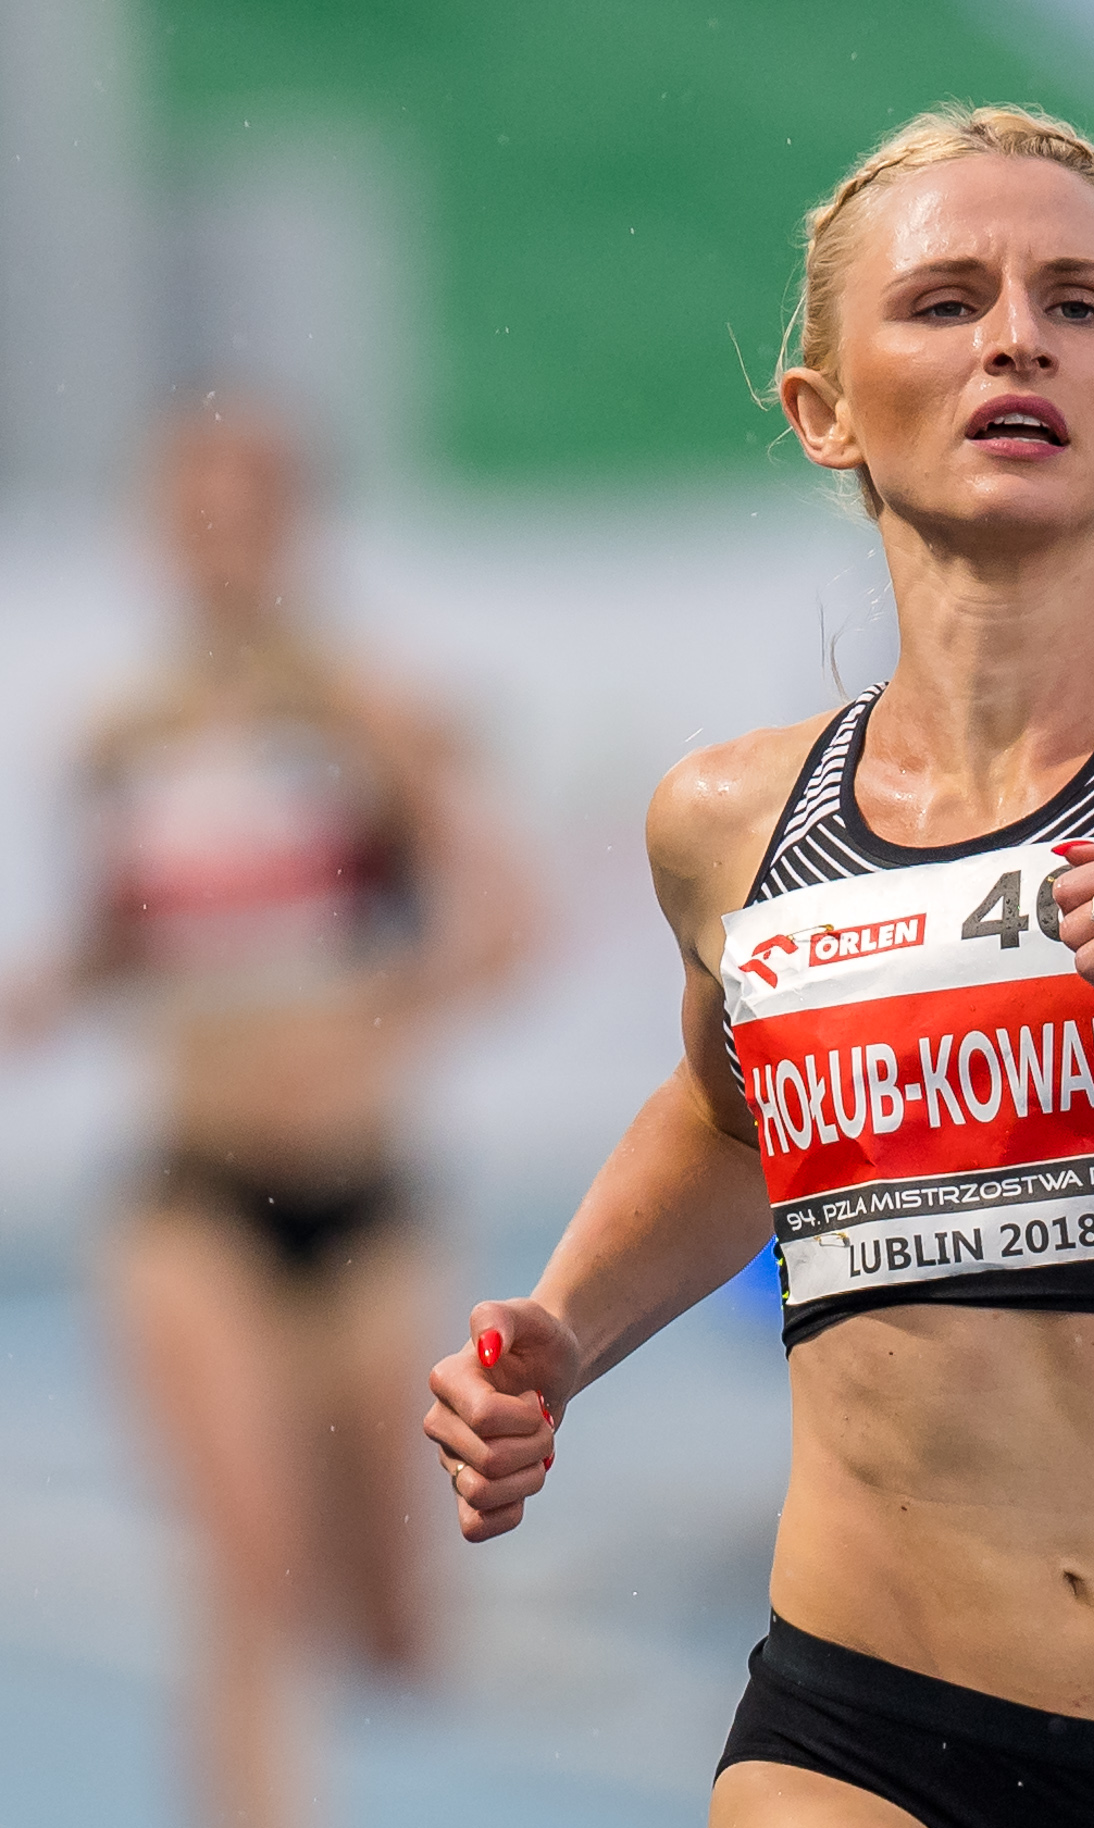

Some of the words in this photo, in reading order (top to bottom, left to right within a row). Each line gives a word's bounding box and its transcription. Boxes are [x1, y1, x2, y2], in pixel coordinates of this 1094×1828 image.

[815, 918, 920, 961] ORLEN
[786, 1208, 821, 1232] 94.
[823, 1197, 868, 1224] PZLA
[870, 1169, 1084, 1213] MISTRZOSTWA
[849, 1227, 985, 1278] LUBLIN
